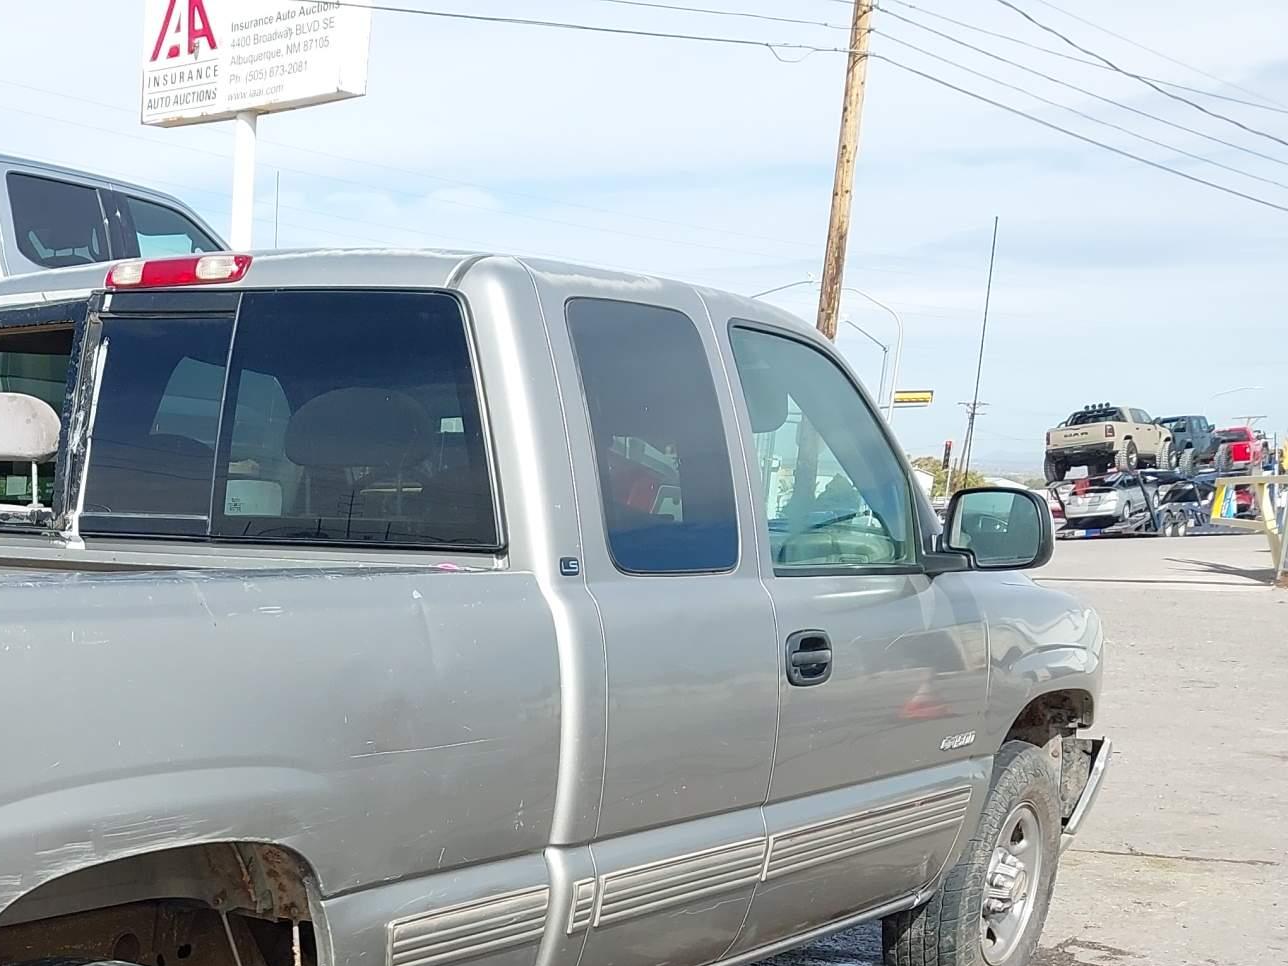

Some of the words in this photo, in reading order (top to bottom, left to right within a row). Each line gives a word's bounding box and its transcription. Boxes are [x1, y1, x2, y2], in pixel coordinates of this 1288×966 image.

[231, 15, 274, 32] Insurance
[275, 8, 297, 23] Auto
[147, 65, 219, 88] INSURANCE
[147, 95, 171, 111] AUTO
[172, 87, 217, 107] AUCTIONS
[561, 560, 579, 572] LS
